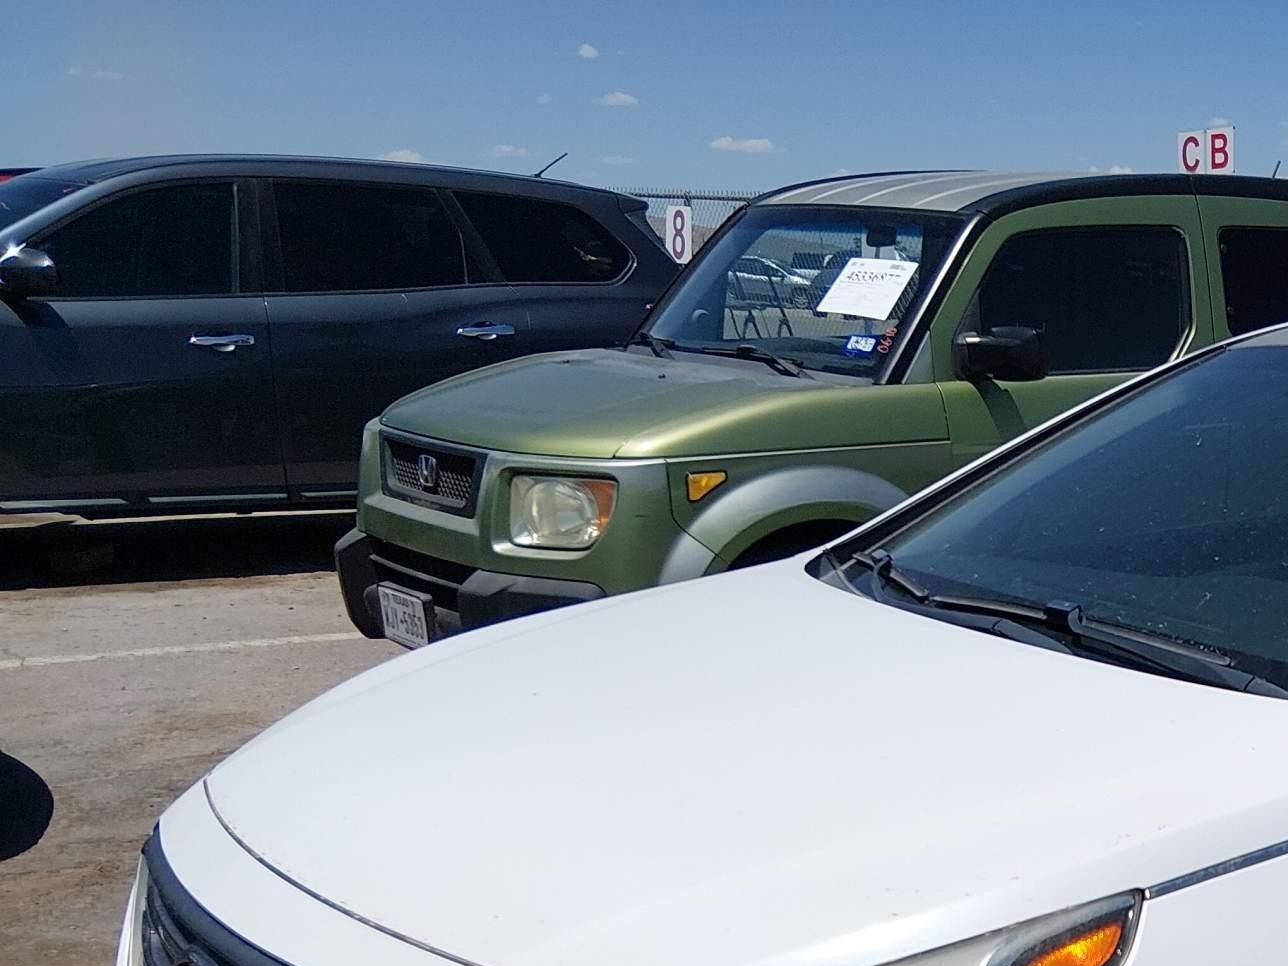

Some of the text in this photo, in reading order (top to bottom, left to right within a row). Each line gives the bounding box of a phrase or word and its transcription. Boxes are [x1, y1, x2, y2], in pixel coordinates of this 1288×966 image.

[1182, 133, 1229, 173] C B
[672, 209, 686, 260] 8
